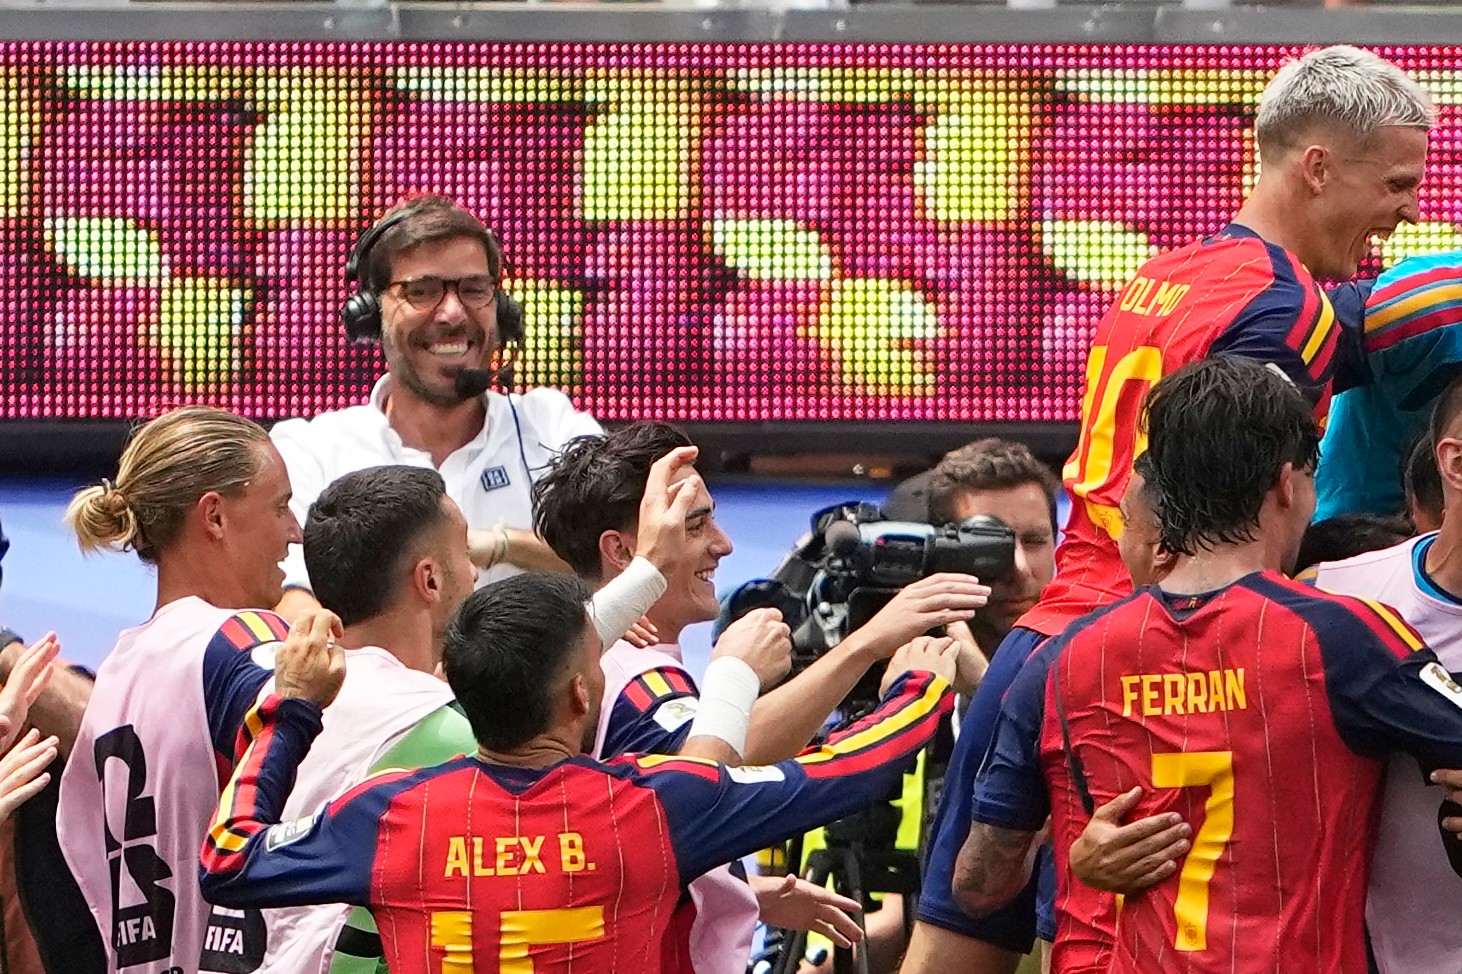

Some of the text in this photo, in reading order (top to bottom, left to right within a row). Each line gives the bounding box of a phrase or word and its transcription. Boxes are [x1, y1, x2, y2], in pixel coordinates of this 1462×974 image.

[1120, 277, 1190, 317] OLMO
[1120, 668, 1247, 717] FERRAN
[444, 832, 596, 878] ALEX B.
[1152, 751, 1235, 951] 7
